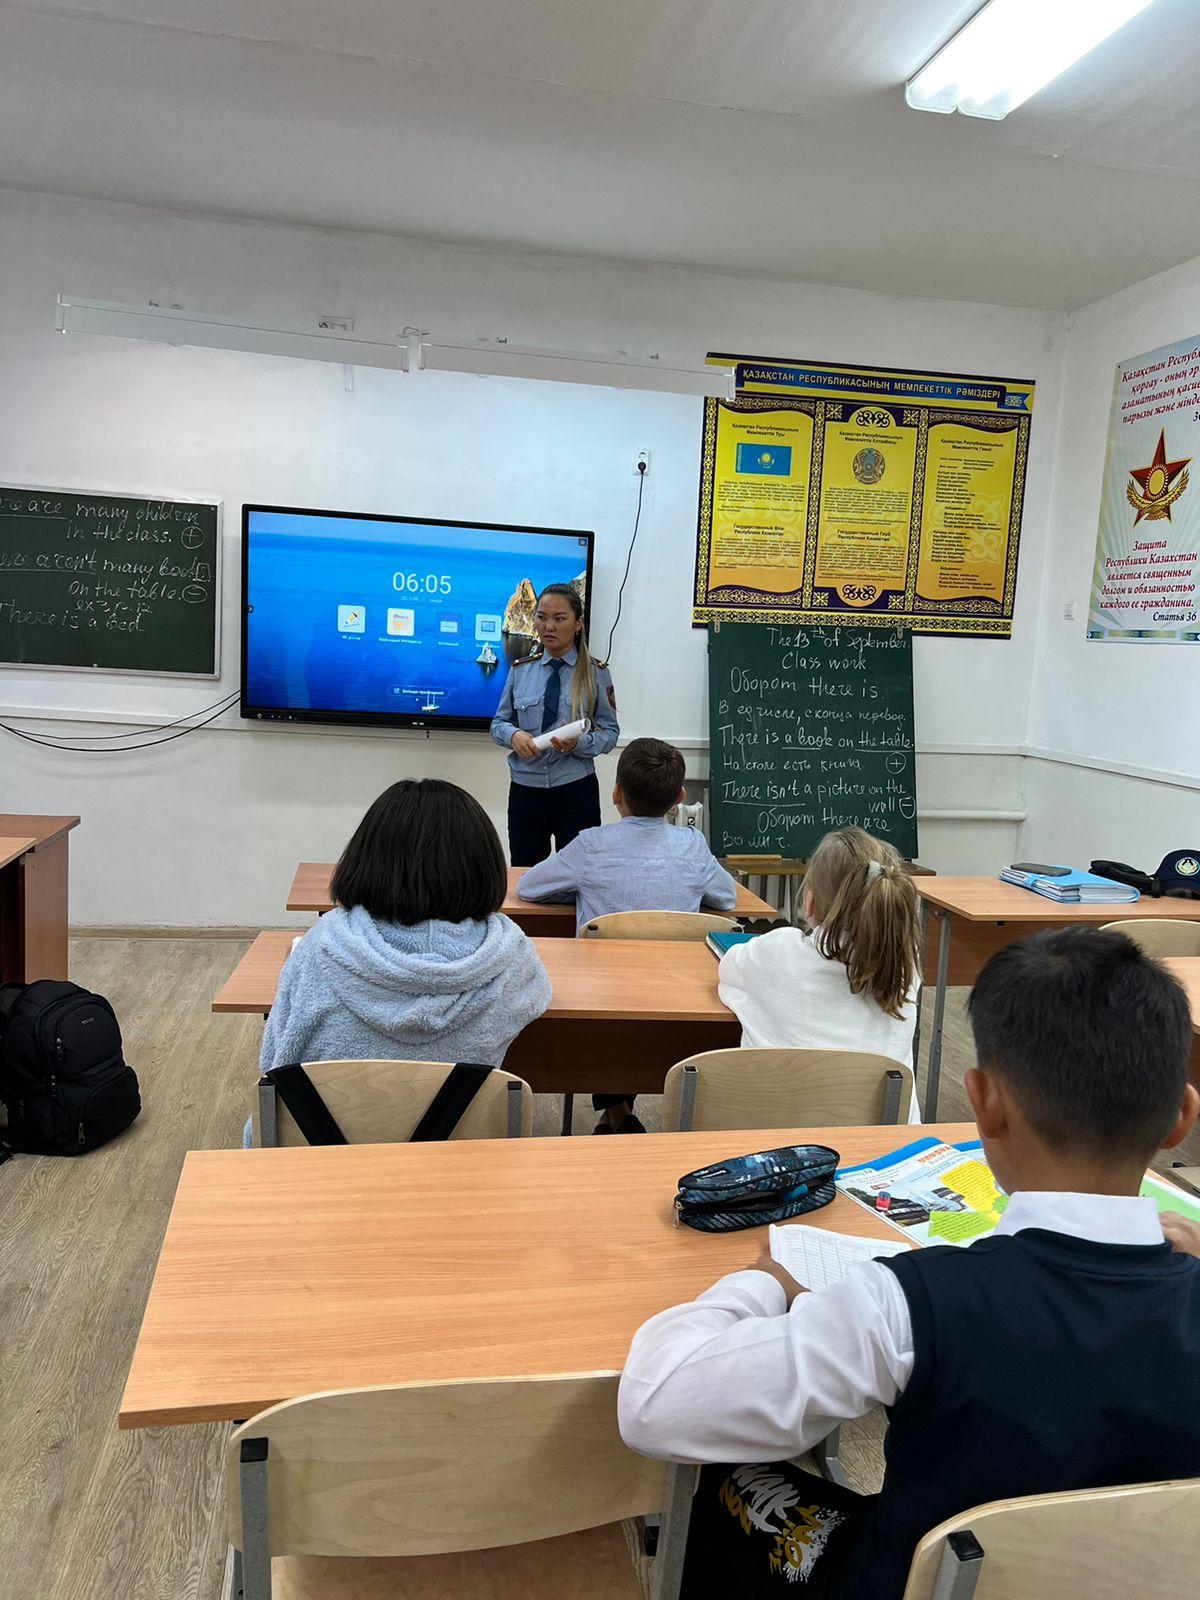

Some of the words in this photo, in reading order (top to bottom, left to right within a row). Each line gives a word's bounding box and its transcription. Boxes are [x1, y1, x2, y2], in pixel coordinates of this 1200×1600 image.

[1189, 365, 1200, 378] әр
[742, 368, 795, 382] ҚАЗАҚСТАН
[799, 373, 890, 391] РЕСПУБЛИКАСЫНЫҢ
[894, 382, 953, 395] МЕМЛЕКЕТТІК
[956, 387, 1002, 399] РӘМІЗДЕРІ
[1133, 540, 1167, 552] Защита
[1105, 555, 1148, 570] Республики
[1149, 552, 1198, 565] Казахстан
[391, 571, 452, 594] 06:05
[1106, 571, 1142, 581] является
[1143, 568, 1192, 581] священным
[1101, 584, 1126, 595] долгом
[1134, 583, 1196, 594] обязанностью
[1099, 598, 1130, 609] каждого
[1140, 596, 1194, 611] гражданина.
[1152, 611, 1185, 622] Статья
[1186, 610, 1197, 622] 36
[823, 628, 841, 648] of
[781, 650, 821, 670] Class
[730, 667, 797, 698] Оборот
[808, 676, 852, 697] there
[718, 723, 760, 748] There
[765, 728, 779, 745] is
[784, 734, 793, 744] a
[798, 726, 834, 748] book
[838, 737, 854, 747] on
[858, 730, 878, 748] the
[722, 780, 762, 799] There
[765, 779, 801, 799] isn't
[804, 783, 812, 794] a
[817, 777, 865, 803] picture
